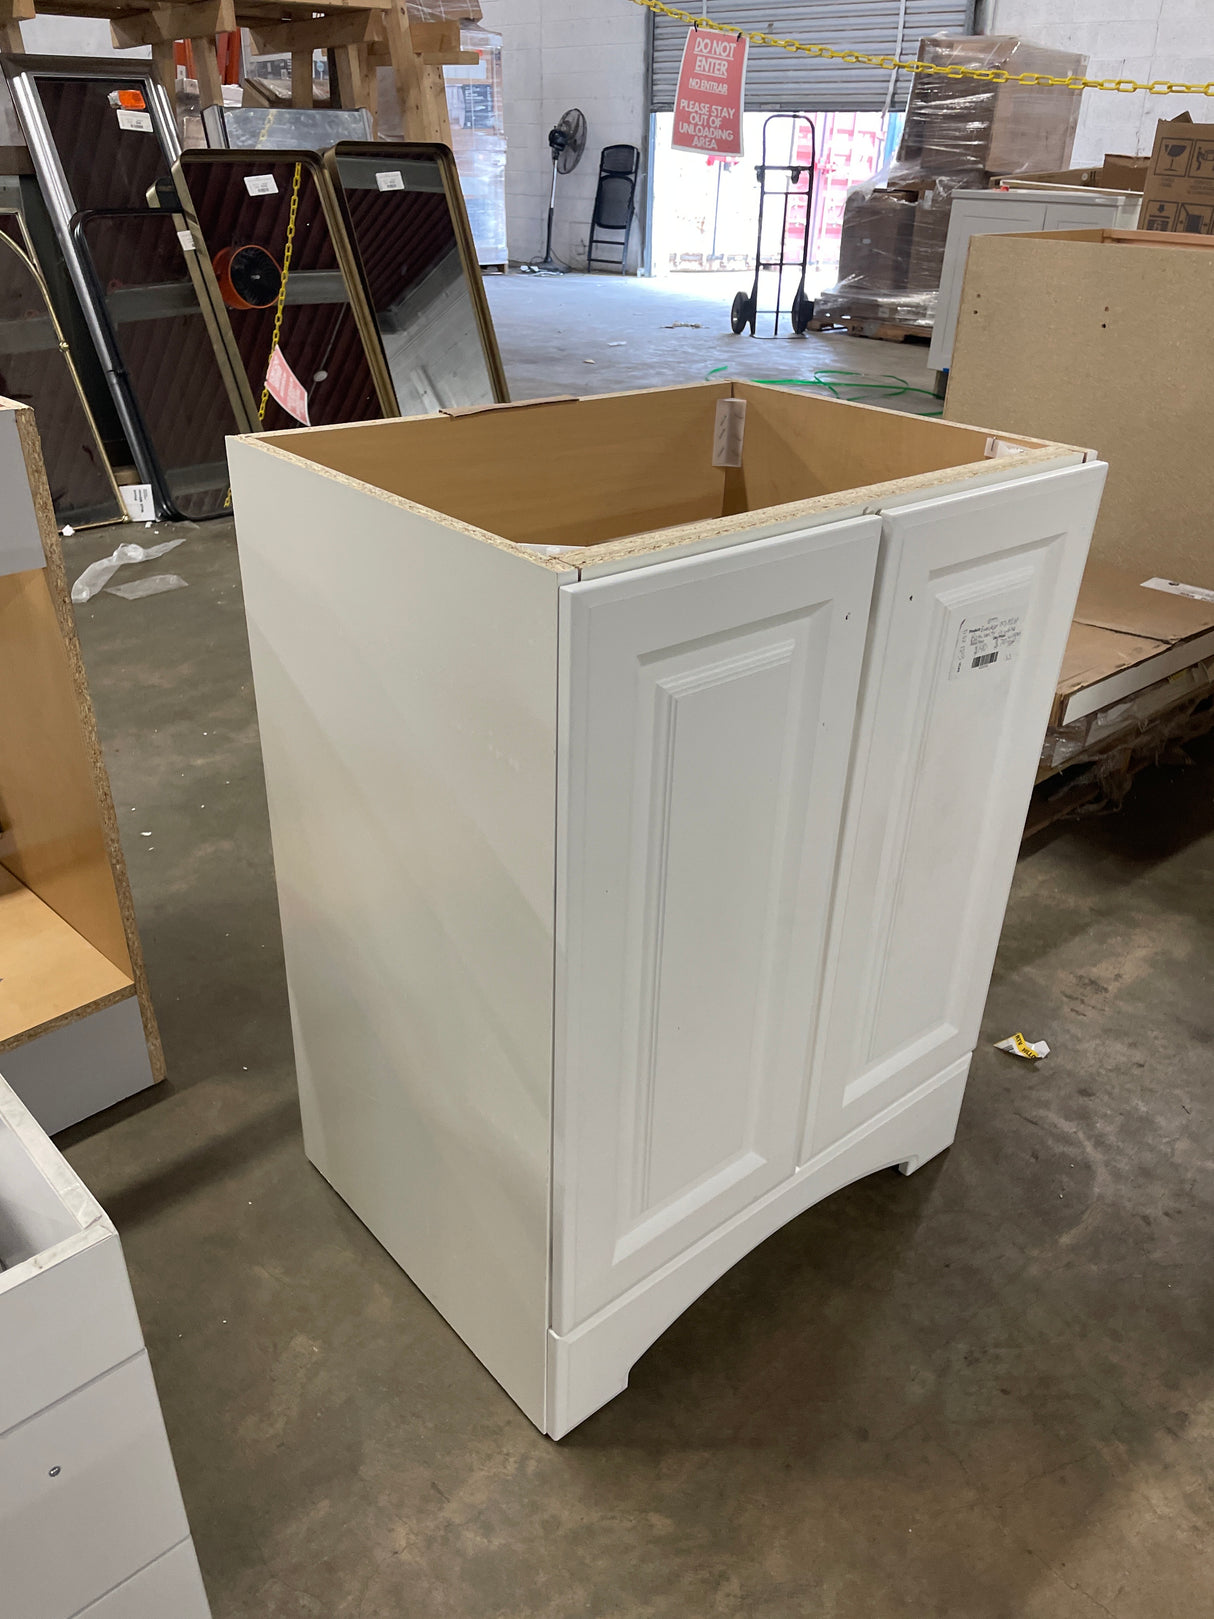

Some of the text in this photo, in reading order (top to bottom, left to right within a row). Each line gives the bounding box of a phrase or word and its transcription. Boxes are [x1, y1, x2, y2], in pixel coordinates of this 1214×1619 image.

[694, 37, 736, 58] DO NOT
[695, 56, 728, 76] ENTER
[689, 78, 728, 95] NO ENTRAR
[679, 99, 736, 119] PLEASE STAY
[689, 113, 723, 128] OUT OF
[679, 122, 734, 141] UNLOADING
[692, 136, 718, 150] AREA
